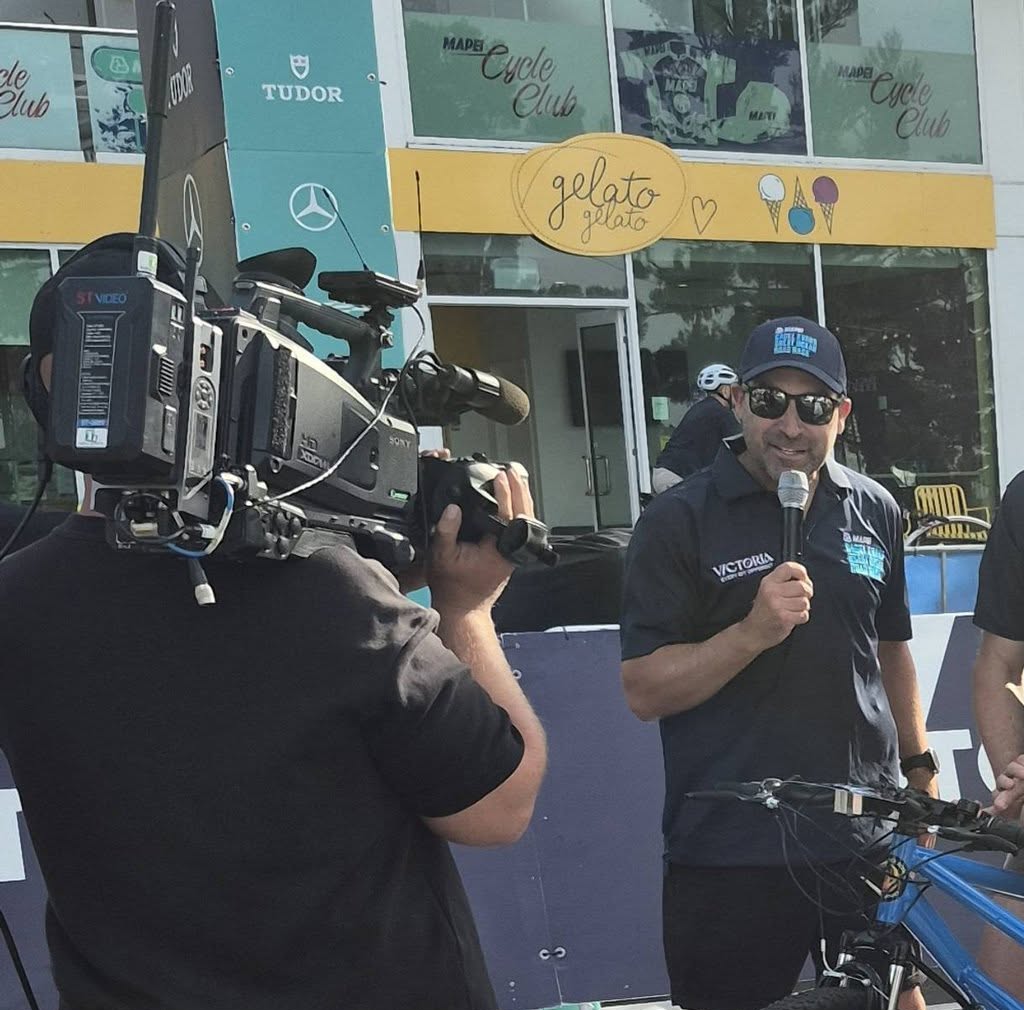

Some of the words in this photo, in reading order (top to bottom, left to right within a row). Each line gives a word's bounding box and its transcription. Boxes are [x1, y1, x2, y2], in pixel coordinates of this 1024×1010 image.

[442, 37, 484, 52] MAPEI
[0, 60, 31, 90] cle
[481, 44, 555, 84] Cycle
[838, 65, 874, 79] MAPEI
[168, 63, 194, 110] UDOR
[262, 83, 343, 103] TUDOR
[513, 83, 577, 118] Club
[870, 71, 932, 108] Cycle
[896, 107, 950, 139] Club
[548, 156, 660, 231] gelato
[581, 197, 648, 244] gelato
[95, 292, 127, 305] VIDEO
[389, 436, 411, 448] SONY
[712, 552, 774, 578] VICTORIA
